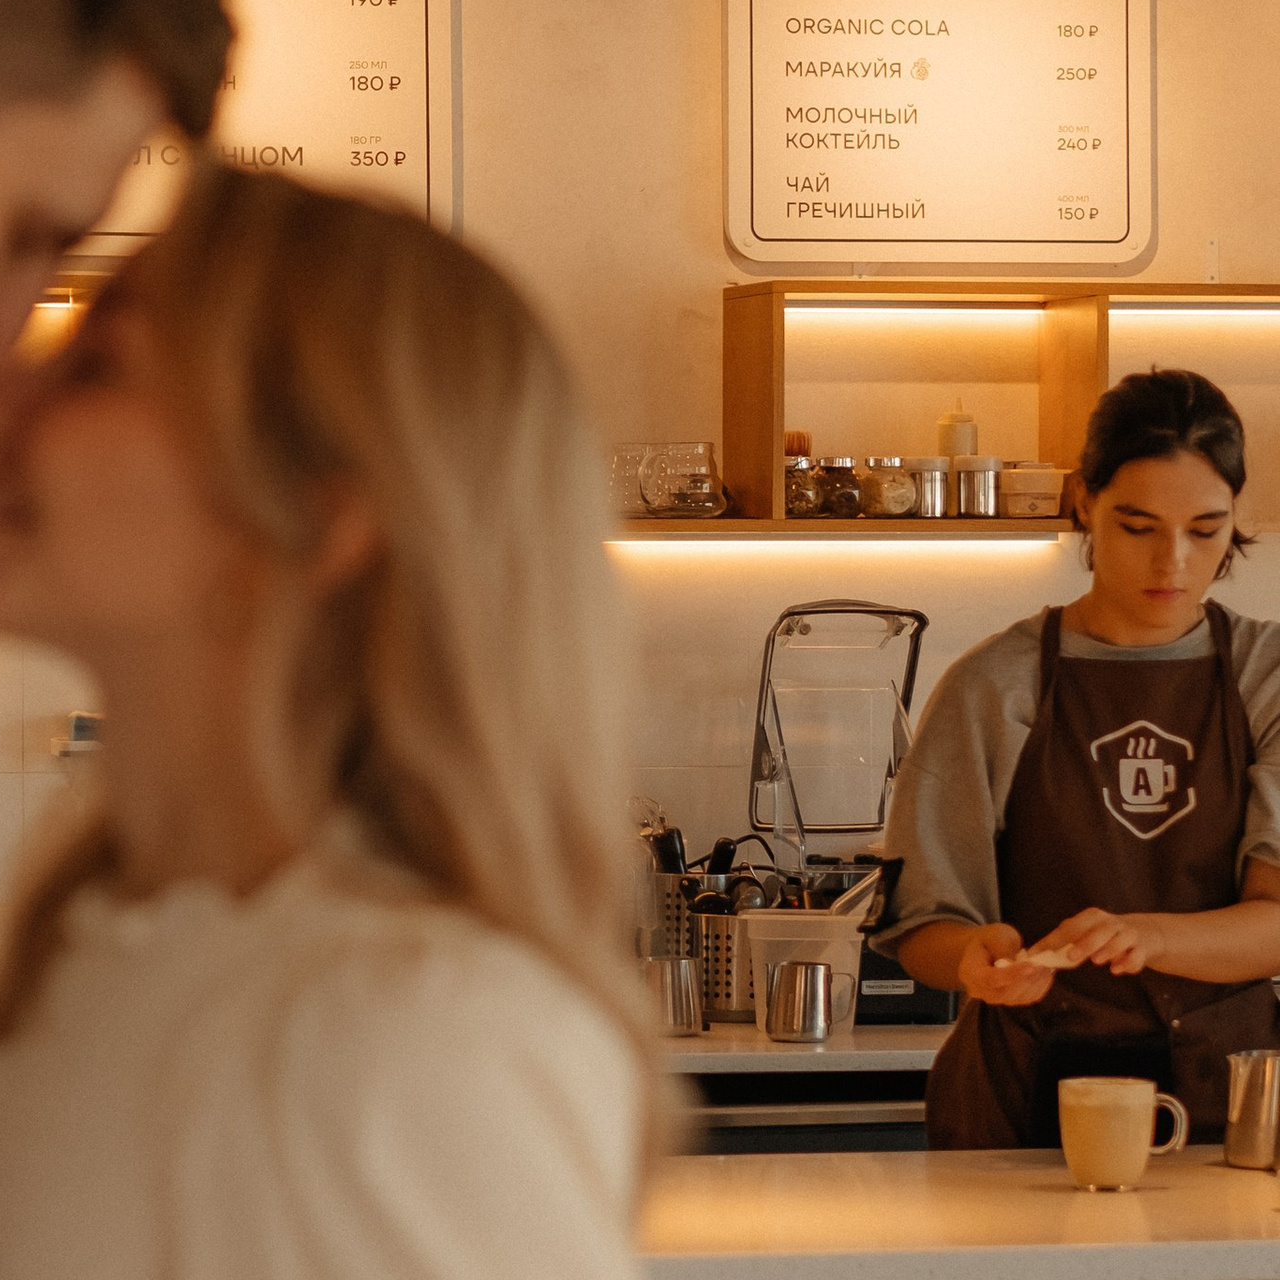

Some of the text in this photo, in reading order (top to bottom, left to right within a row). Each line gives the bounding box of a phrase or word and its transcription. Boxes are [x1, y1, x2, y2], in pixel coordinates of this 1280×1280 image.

[785, 17, 950, 36] ORGANIC COLA
[1057, 24, 1099, 38] 180 ₽
[785, 58, 902, 79] МАРАКУЙЯ
[349, 75, 402, 92] 180 ₽
[785, 104, 918, 125] МОЛОЧНЫЙ
[786, 129, 901, 150] КОКТЕЙЛЬ
[1057, 137, 1102, 151] 240 ₽
[350, 150, 407, 167] 350 ₽
[786, 172, 830, 193] ЧАЙ
[786, 199, 925, 219] ГРЕЧИШНЫЙ
[1057, 207, 1100, 221] 150 ₽
